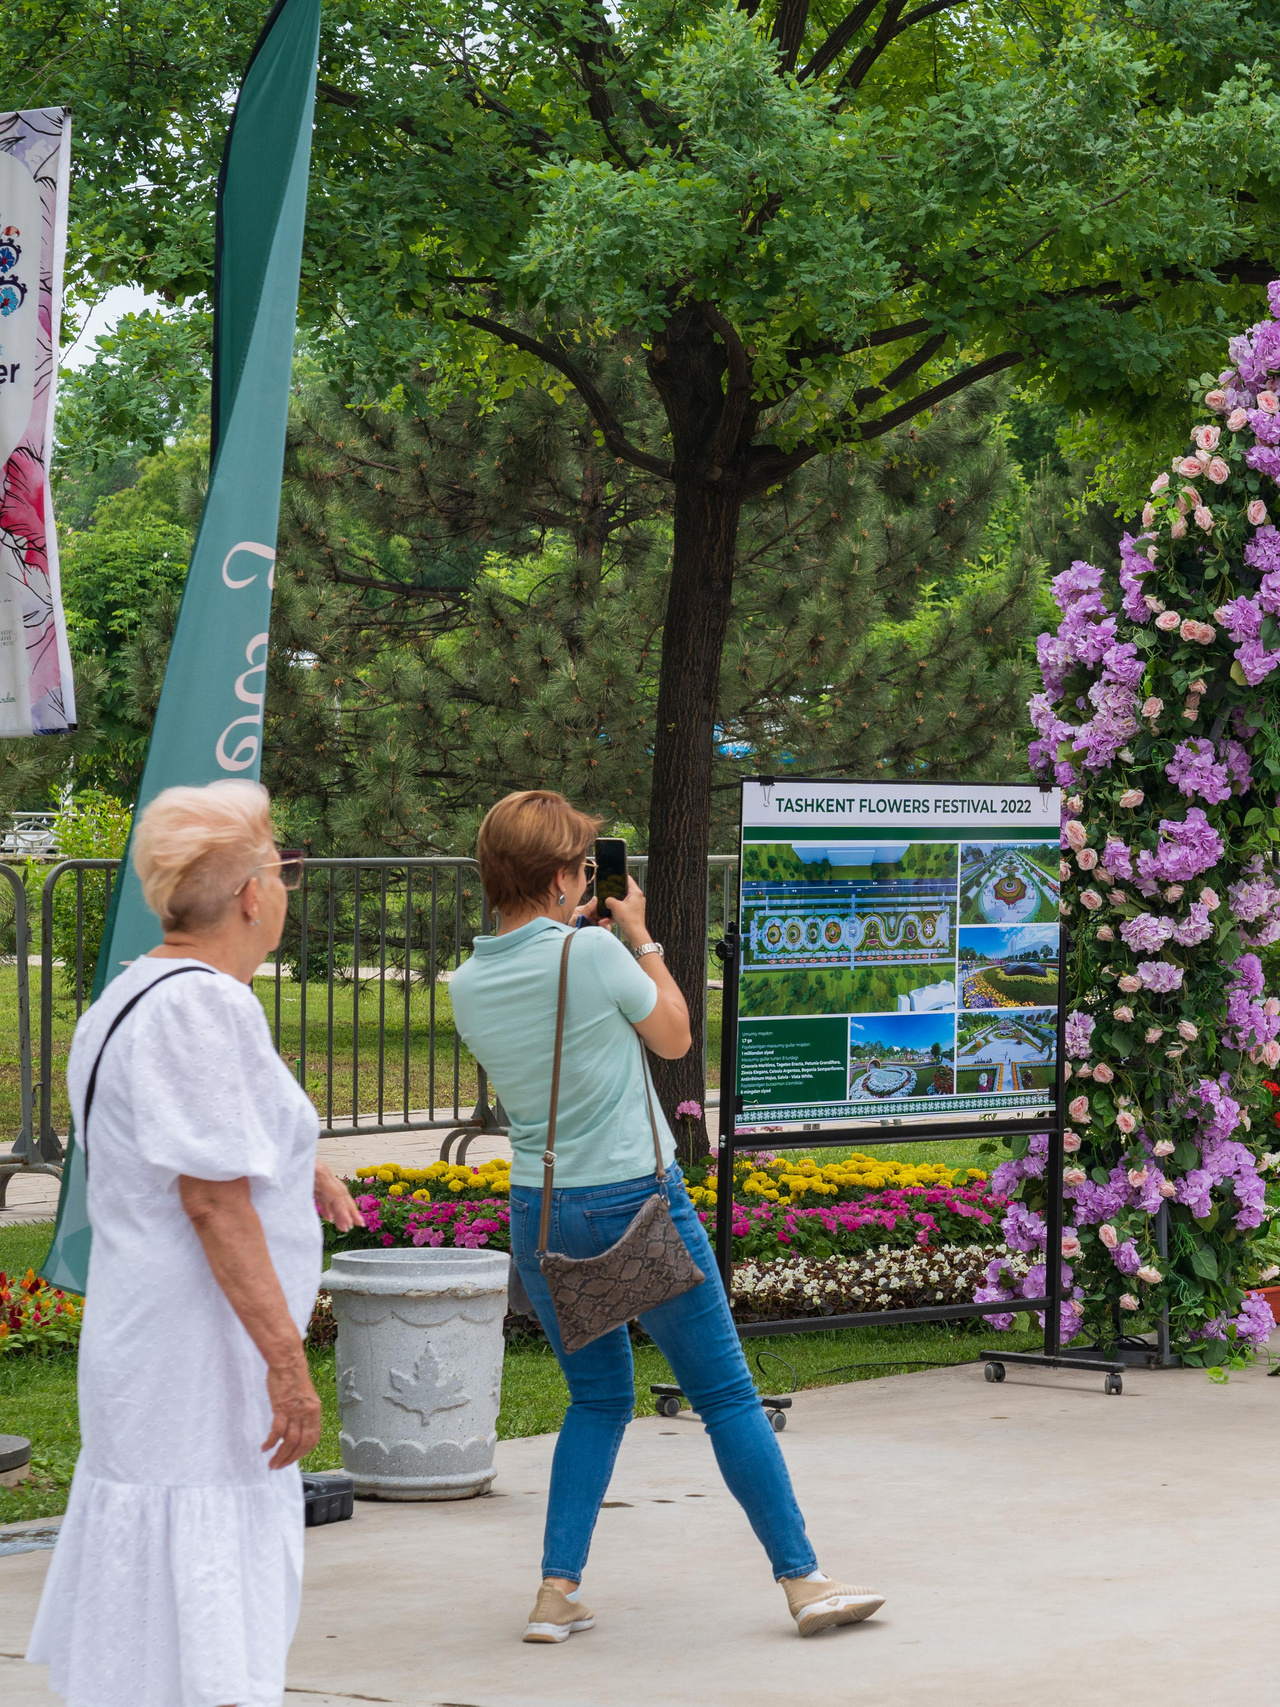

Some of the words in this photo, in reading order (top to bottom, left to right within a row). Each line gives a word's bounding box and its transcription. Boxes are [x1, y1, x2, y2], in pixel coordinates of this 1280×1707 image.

[776, 798, 855, 813] TASHKENT
[859, 798, 930, 814] FLOWERS
[934, 799, 997, 814] FESTIVAL
[1000, 799, 1032, 814] 2022
